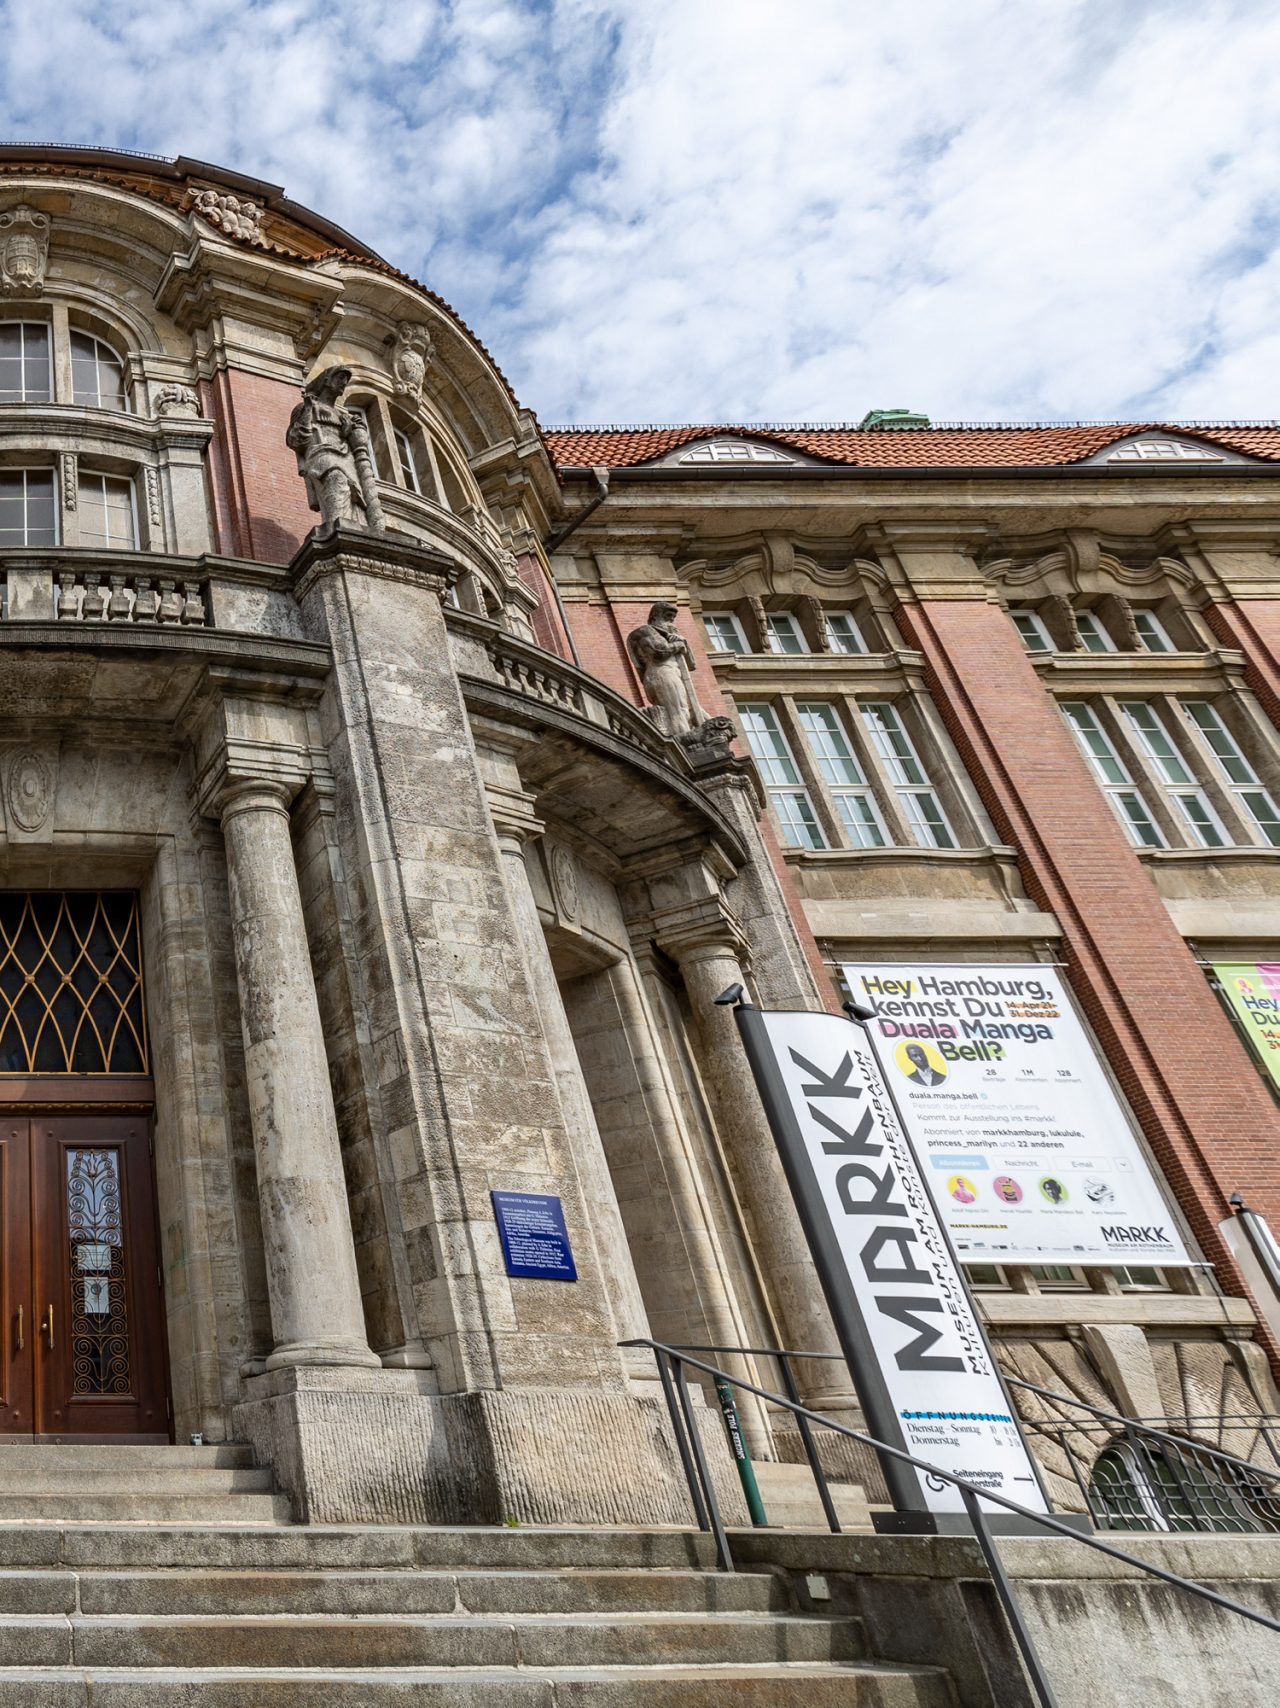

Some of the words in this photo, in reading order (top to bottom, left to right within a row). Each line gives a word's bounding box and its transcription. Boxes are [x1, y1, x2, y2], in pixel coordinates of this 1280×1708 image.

[860, 976, 912, 999] Hey
[917, 976, 1054, 1000] Hamburg,
[869, 996, 960, 1017] kennst
[962, 997, 1005, 1017] Du
[1242, 996, 1278, 1012] Hey
[877, 1018, 957, 1039] Duala
[959, 1019, 1054, 1044] Manga
[937, 1040, 1004, 1062] Bell?
[909, 1092, 979, 1101] duala.manga.bell
[964, 1115, 1010, 1123] Ausstellung
[854, 1050, 918, 1208] ROTHENBAUM
[982, 1128, 1049, 1138] markkhamburg,
[928, 1139, 999, 1149] princess_marilyn
[787, 1045, 967, 1373] MARKK
[915, 1218, 935, 1254] AM
[1100, 1226, 1170, 1242] MARKK
[927, 1226, 948, 1267] und
[932, 1262, 982, 1375] MUSEUM
[907, 1423, 945, 1435] Dienstag
[951, 1423, 981, 1435] Sonntag
[910, 1435, 960, 1447] Donnerstag
[953, 1469, 1004, 1479] Seiteneingang
